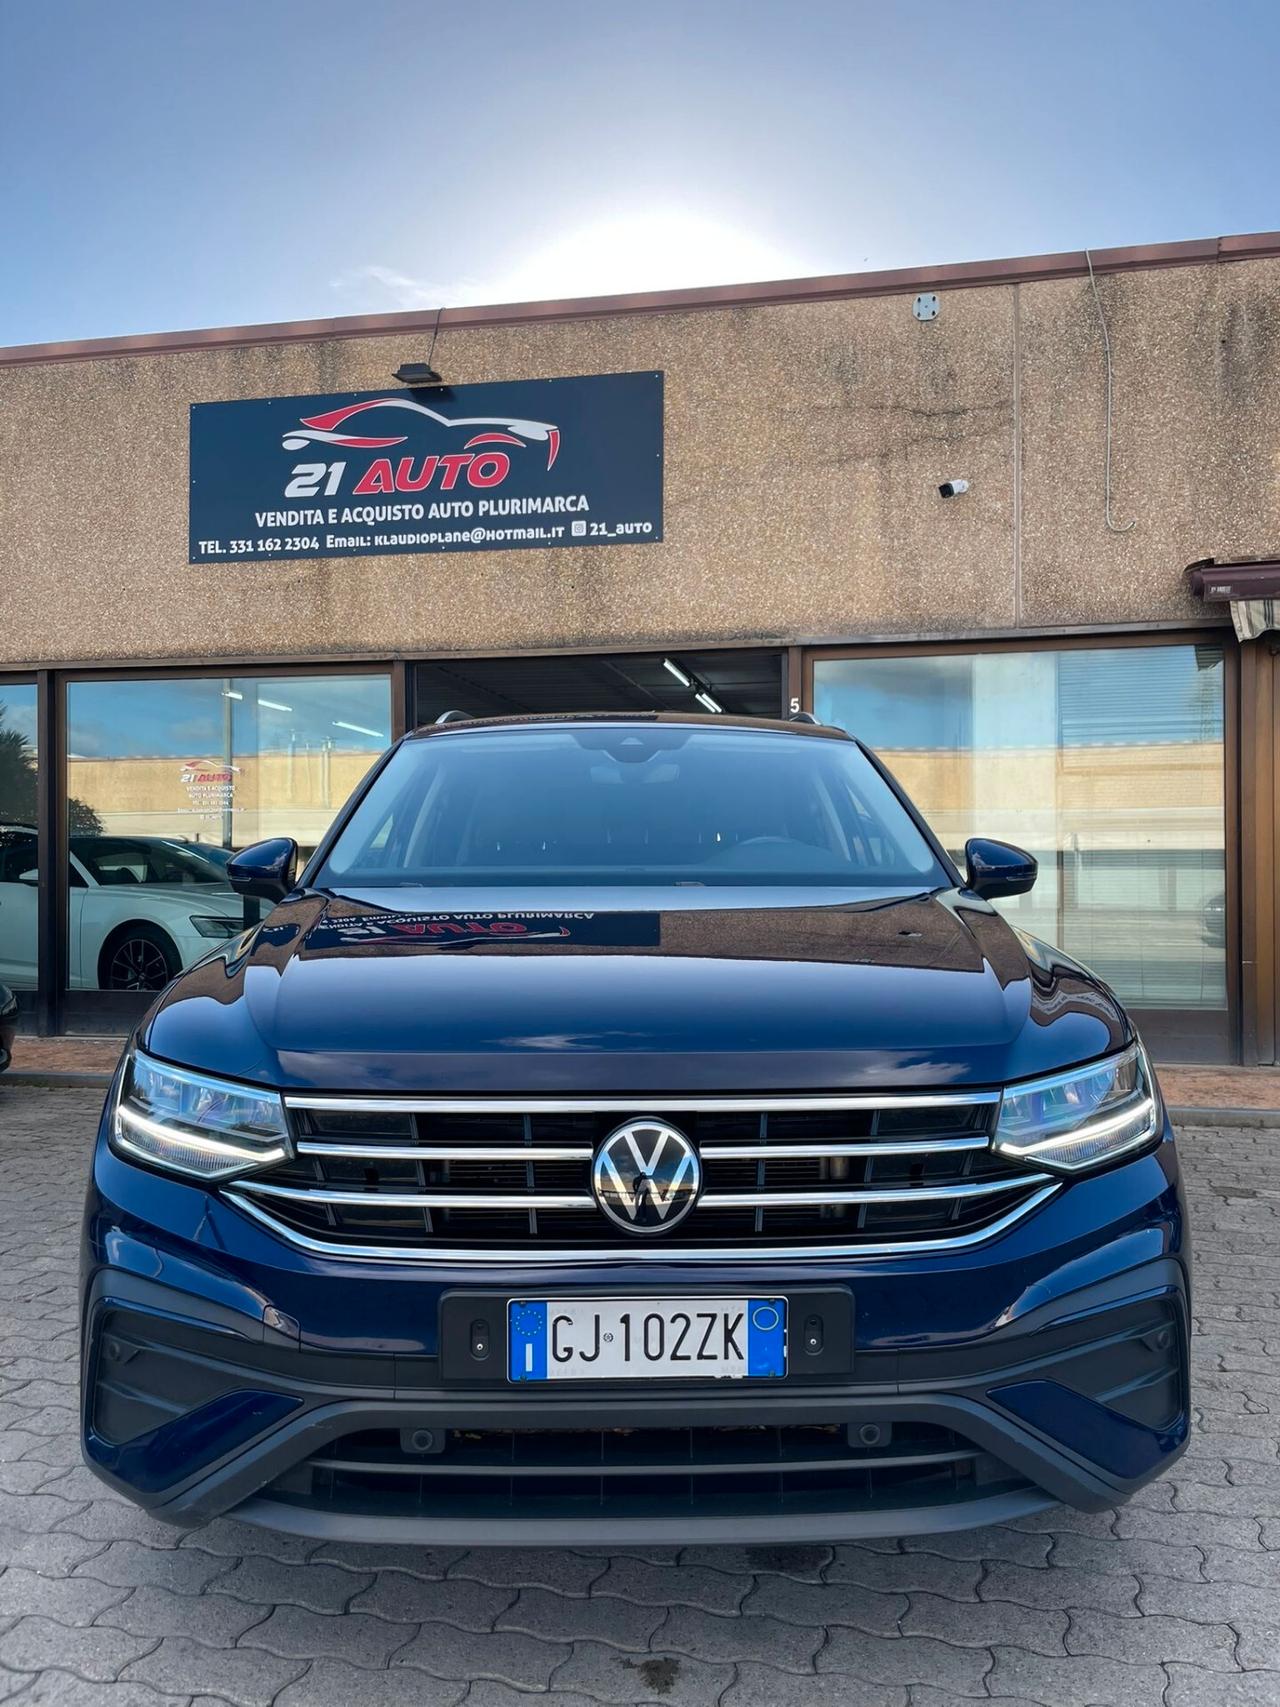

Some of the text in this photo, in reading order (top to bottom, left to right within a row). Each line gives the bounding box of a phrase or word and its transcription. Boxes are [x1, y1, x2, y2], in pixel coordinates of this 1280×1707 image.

[284, 452, 511, 498] 21 AUTO
[255, 495, 590, 528] VENDITA E ACQUISTO AUTO PLURIMARCA
[199, 540, 227, 555] TEL.
[229, 539, 254, 554] 331
[257, 538, 282, 552] 162
[285, 536, 320, 551] 2304
[790, 697, 800, 713] 5
